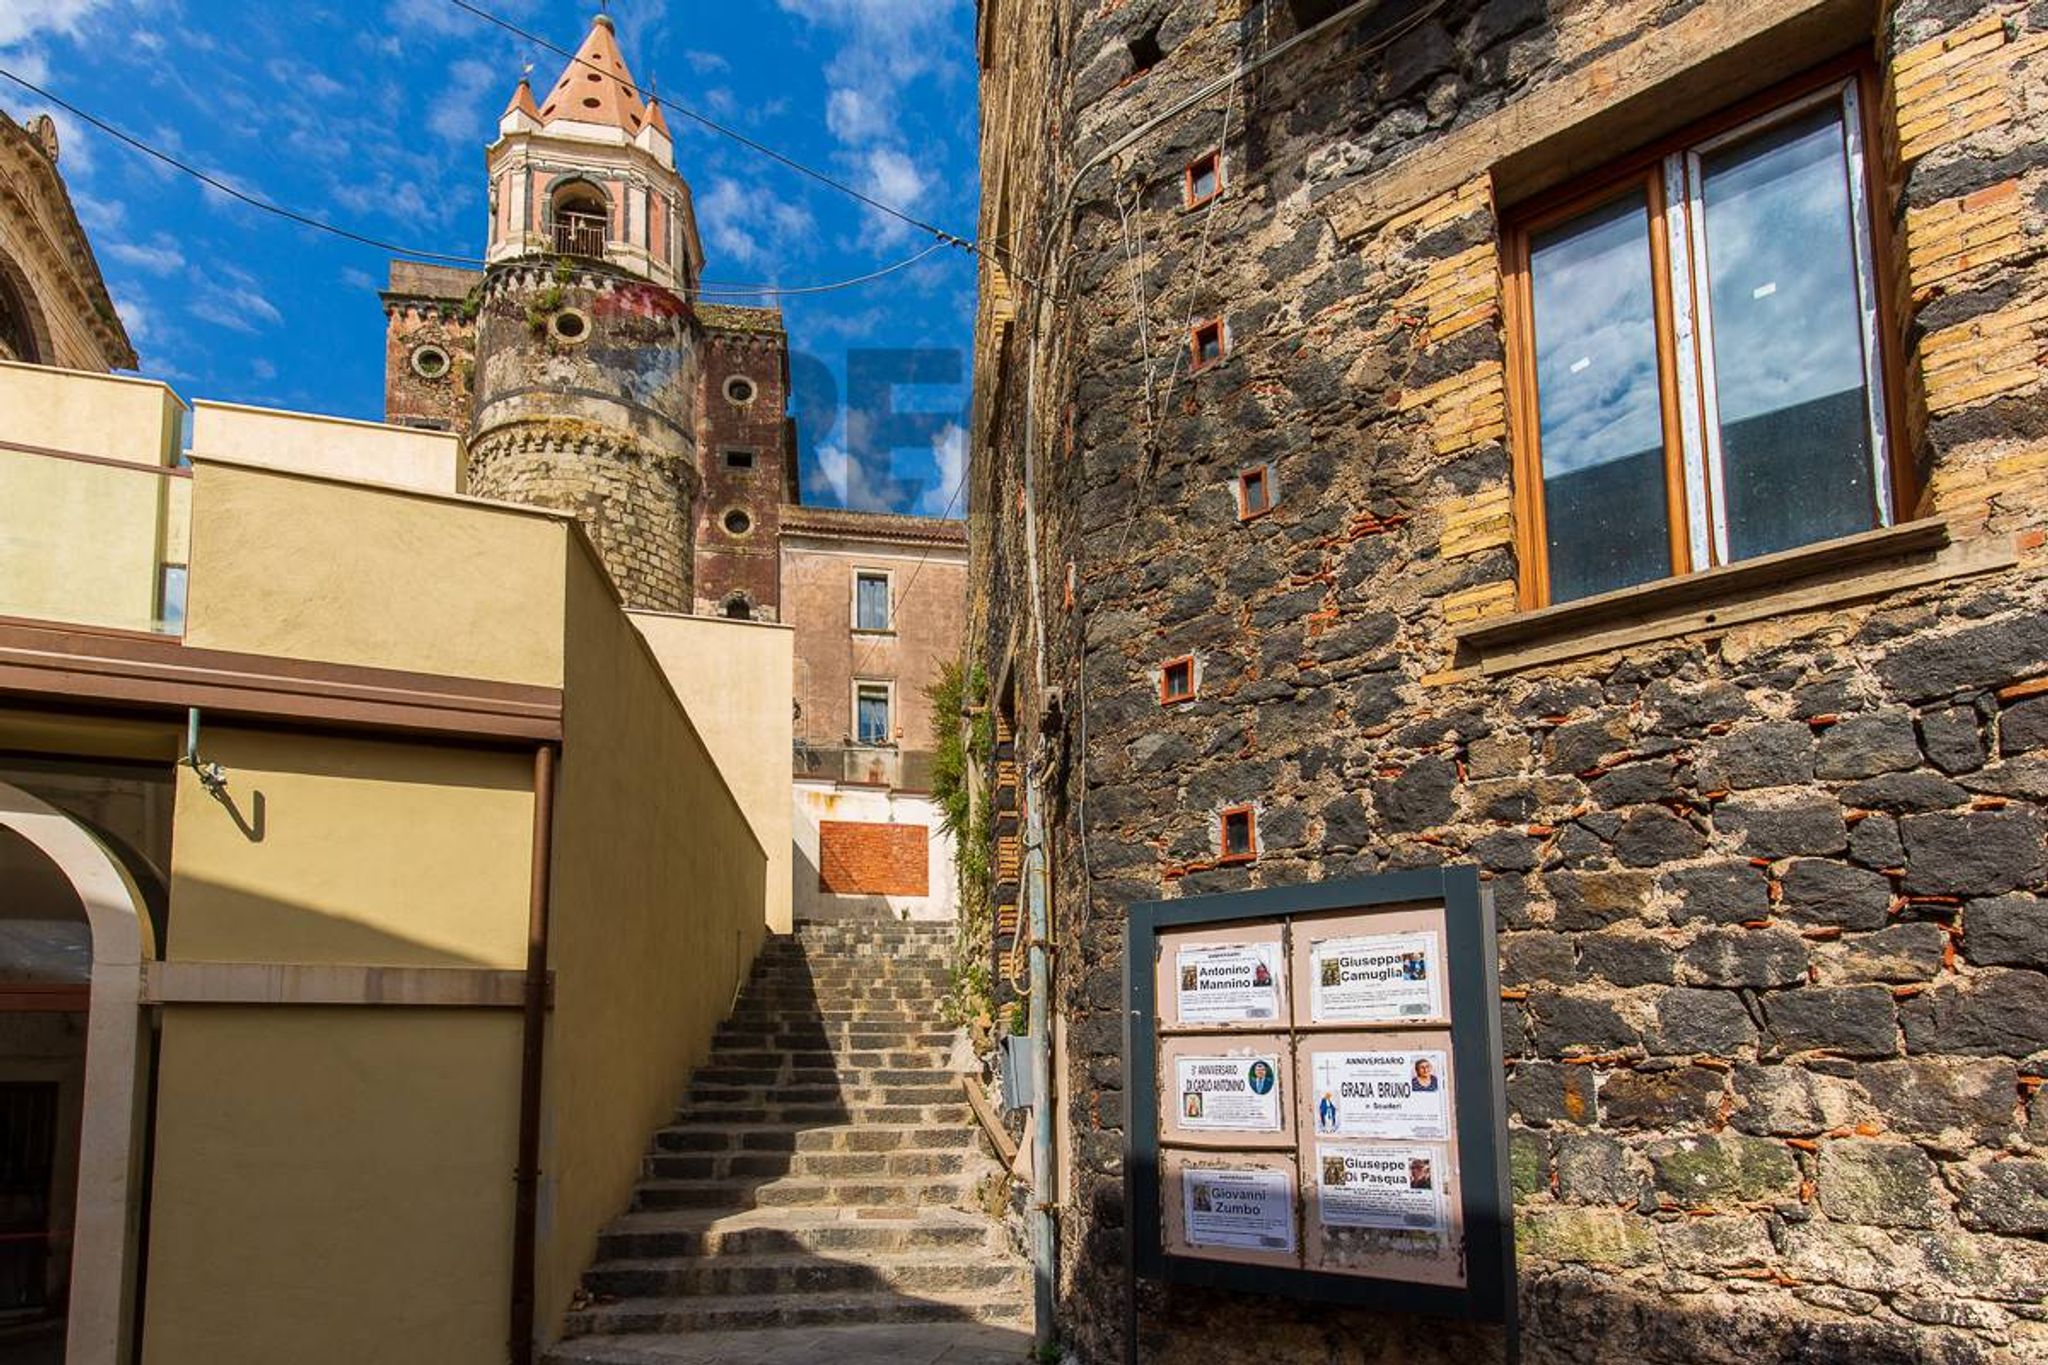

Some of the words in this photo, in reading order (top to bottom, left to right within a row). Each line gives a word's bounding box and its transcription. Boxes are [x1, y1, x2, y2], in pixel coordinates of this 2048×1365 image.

[1340, 954, 1402, 968] Giuseppa
[1199, 964, 1251, 977] Antonino
[1340, 967, 1403, 982] Camuglia
[1199, 978, 1251, 990] Mannino
[1345, 1056, 1405, 1066] ANNIVERSARIO
[1193, 1079, 1212, 1092] CARLO
[1213, 1079, 1246, 1092] ANTONINO
[1341, 1081, 1375, 1098] GRAZIA
[1378, 1081, 1411, 1098] BRUNO
[1344, 1158, 1405, 1171] Giuseppe
[1345, 1172, 1358, 1182] Di
[1361, 1172, 1408, 1186] Pasqua
[1211, 1188, 1266, 1201] Giovanni
[1215, 1201, 1261, 1216] Zumbo
